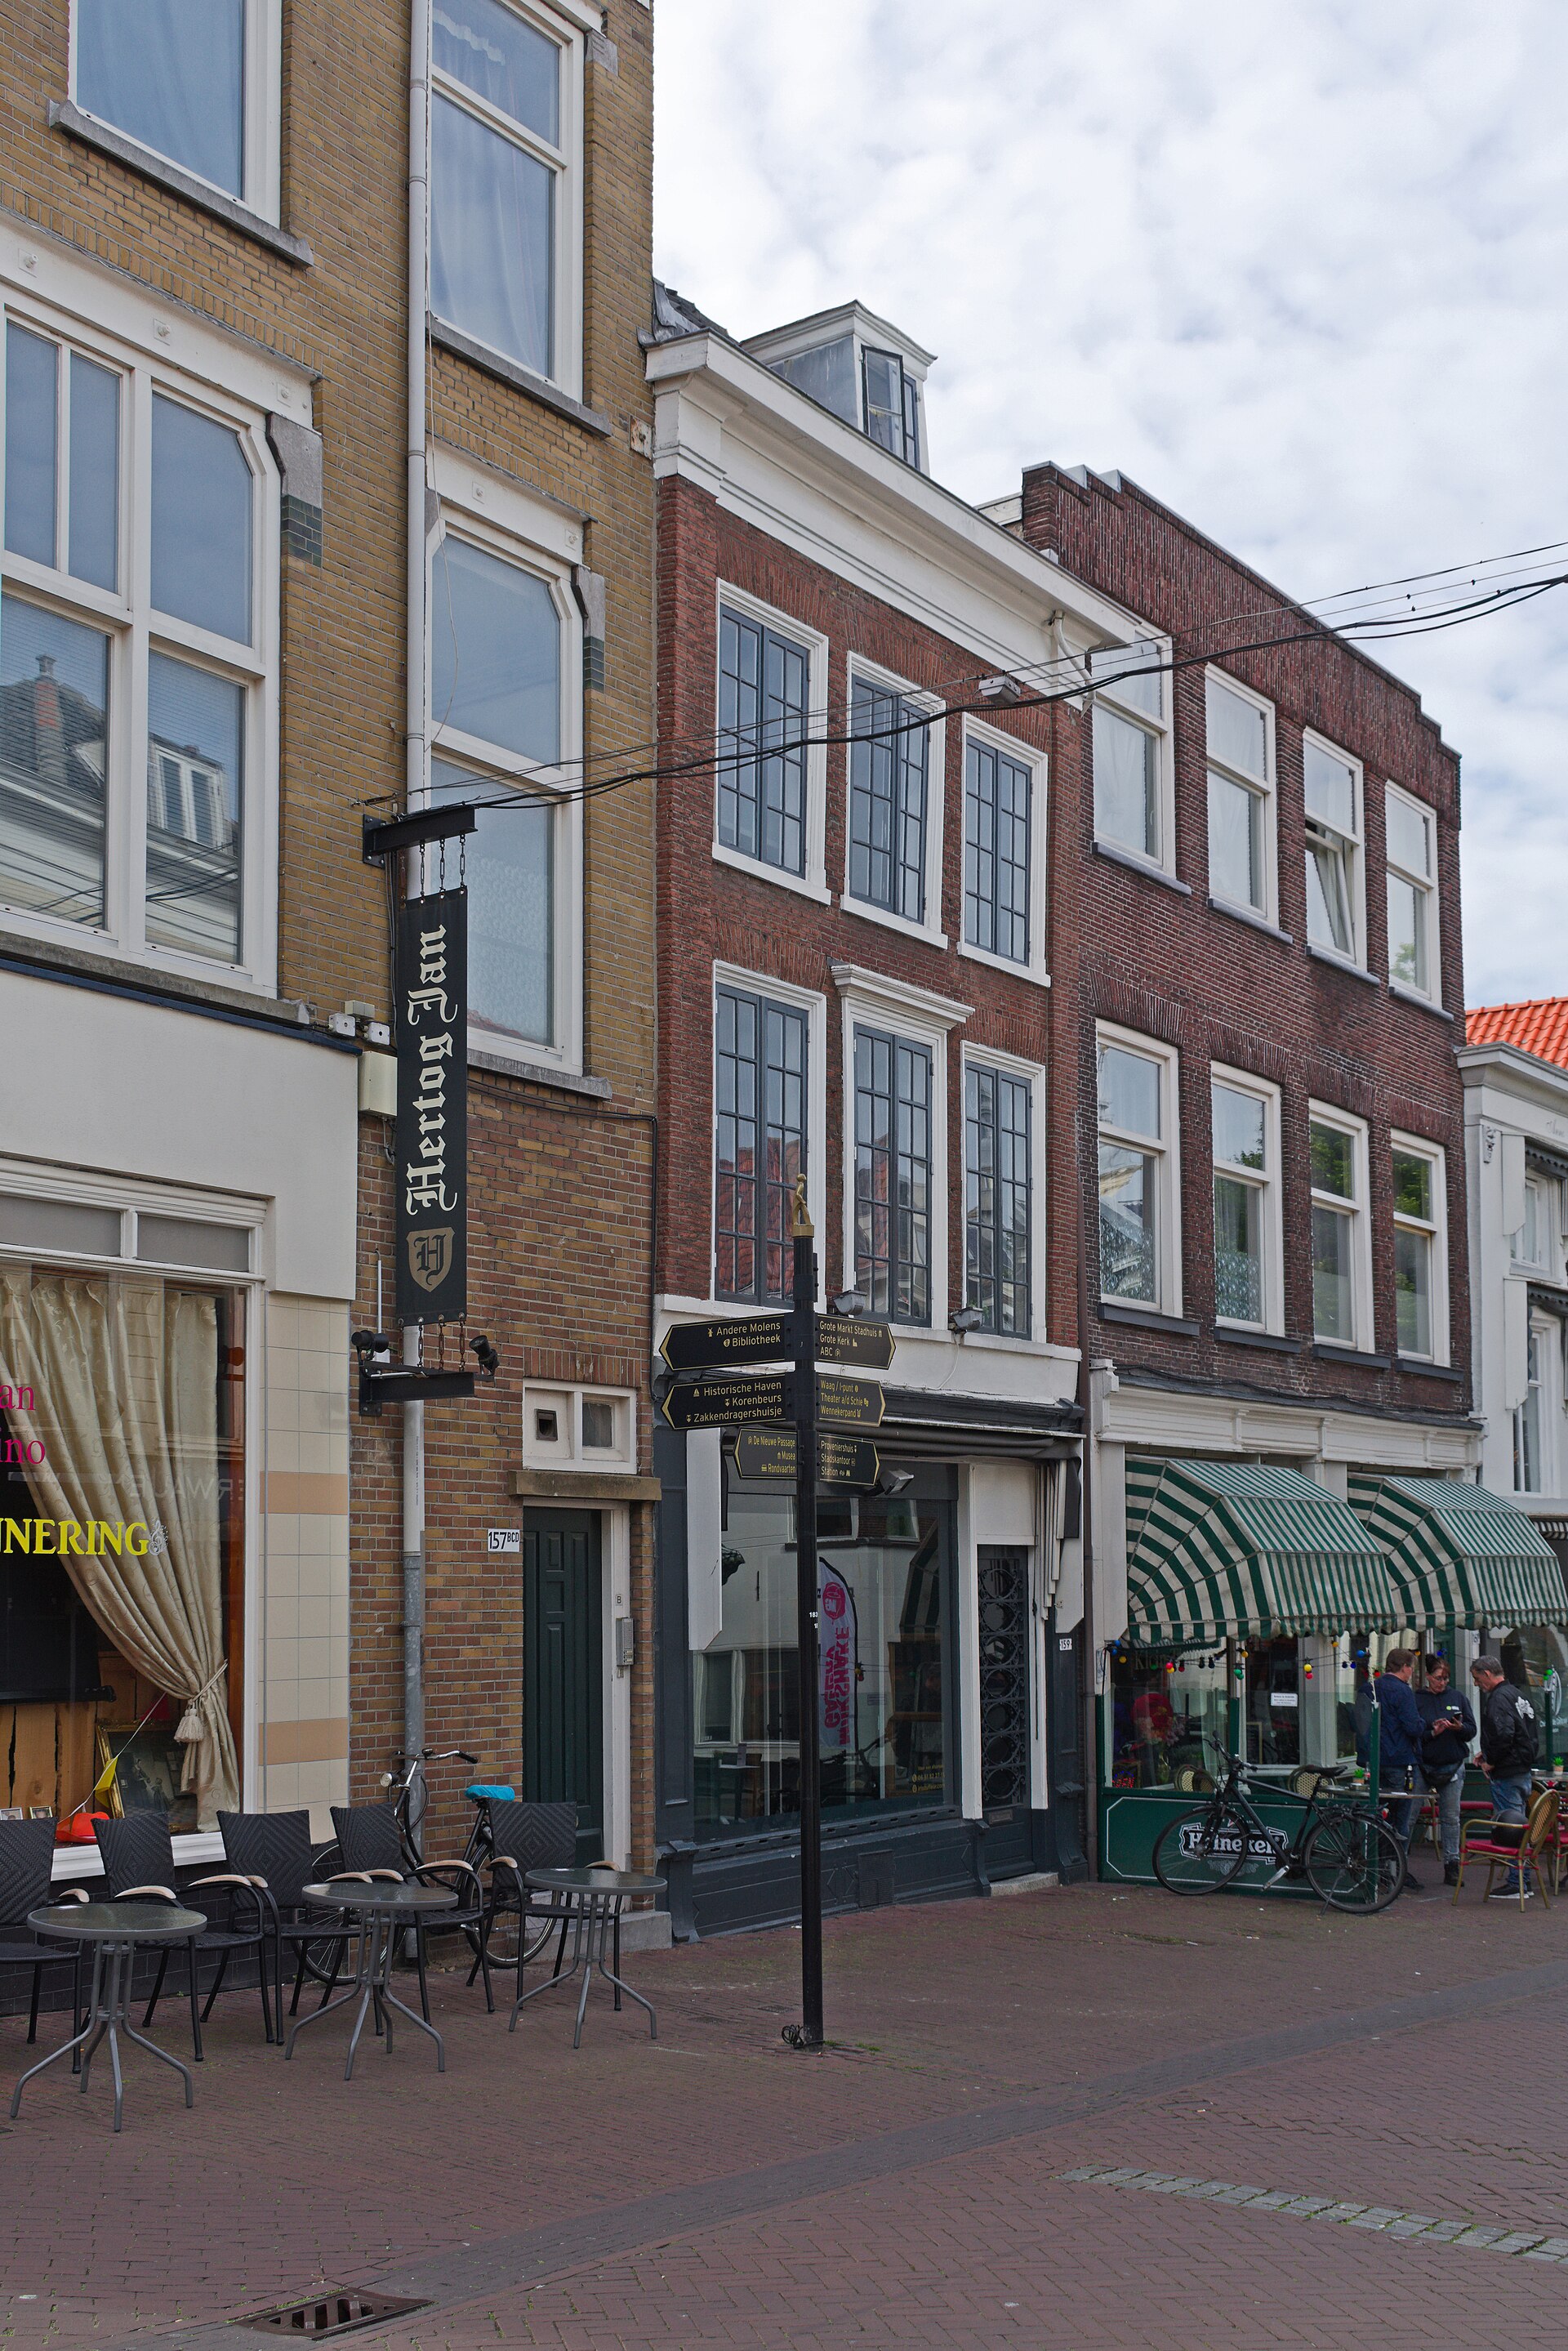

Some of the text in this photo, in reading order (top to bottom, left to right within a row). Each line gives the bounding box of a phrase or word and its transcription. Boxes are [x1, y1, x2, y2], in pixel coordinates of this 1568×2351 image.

[406, 923, 459, 1216] Hertog Jan
[716, 1322, 781, 1336] Andere Molens
[819, 1320, 877, 1337] Grote Markt Stadhuis
[732, 1333, 781, 1347] Bibliotheek
[819, 1333, 850, 1345] Grote Kerk
[820, 1346, 833, 1356] ABC
[704, 1381, 782, 1396] Historische Haven
[820, 1380, 835, 1392] Waag
[732, 1394, 782, 1407] Korenbeurs
[821, 1392, 840, 1403] Theater
[851, 1396, 862, 1406] Schie
[693, 1405, 782, 1423] Zakkendragershuisje
[821, 1405, 857, 1418] Wennekerpand
[753, 1435, 795, 1448] De Nieuwe Passage
[821, 1440, 853, 1453] Proveniershuis
[782, 1450, 795, 1460] Musea
[821, 1453, 850, 1465] Stadskantoor
[768, 1463, 796, 1474] Rondvaarten
[821, 1465, 838, 1476] Station
[0, 1518, 149, 1556] NERING
[1061, 1639, 1070, 1649] 159
